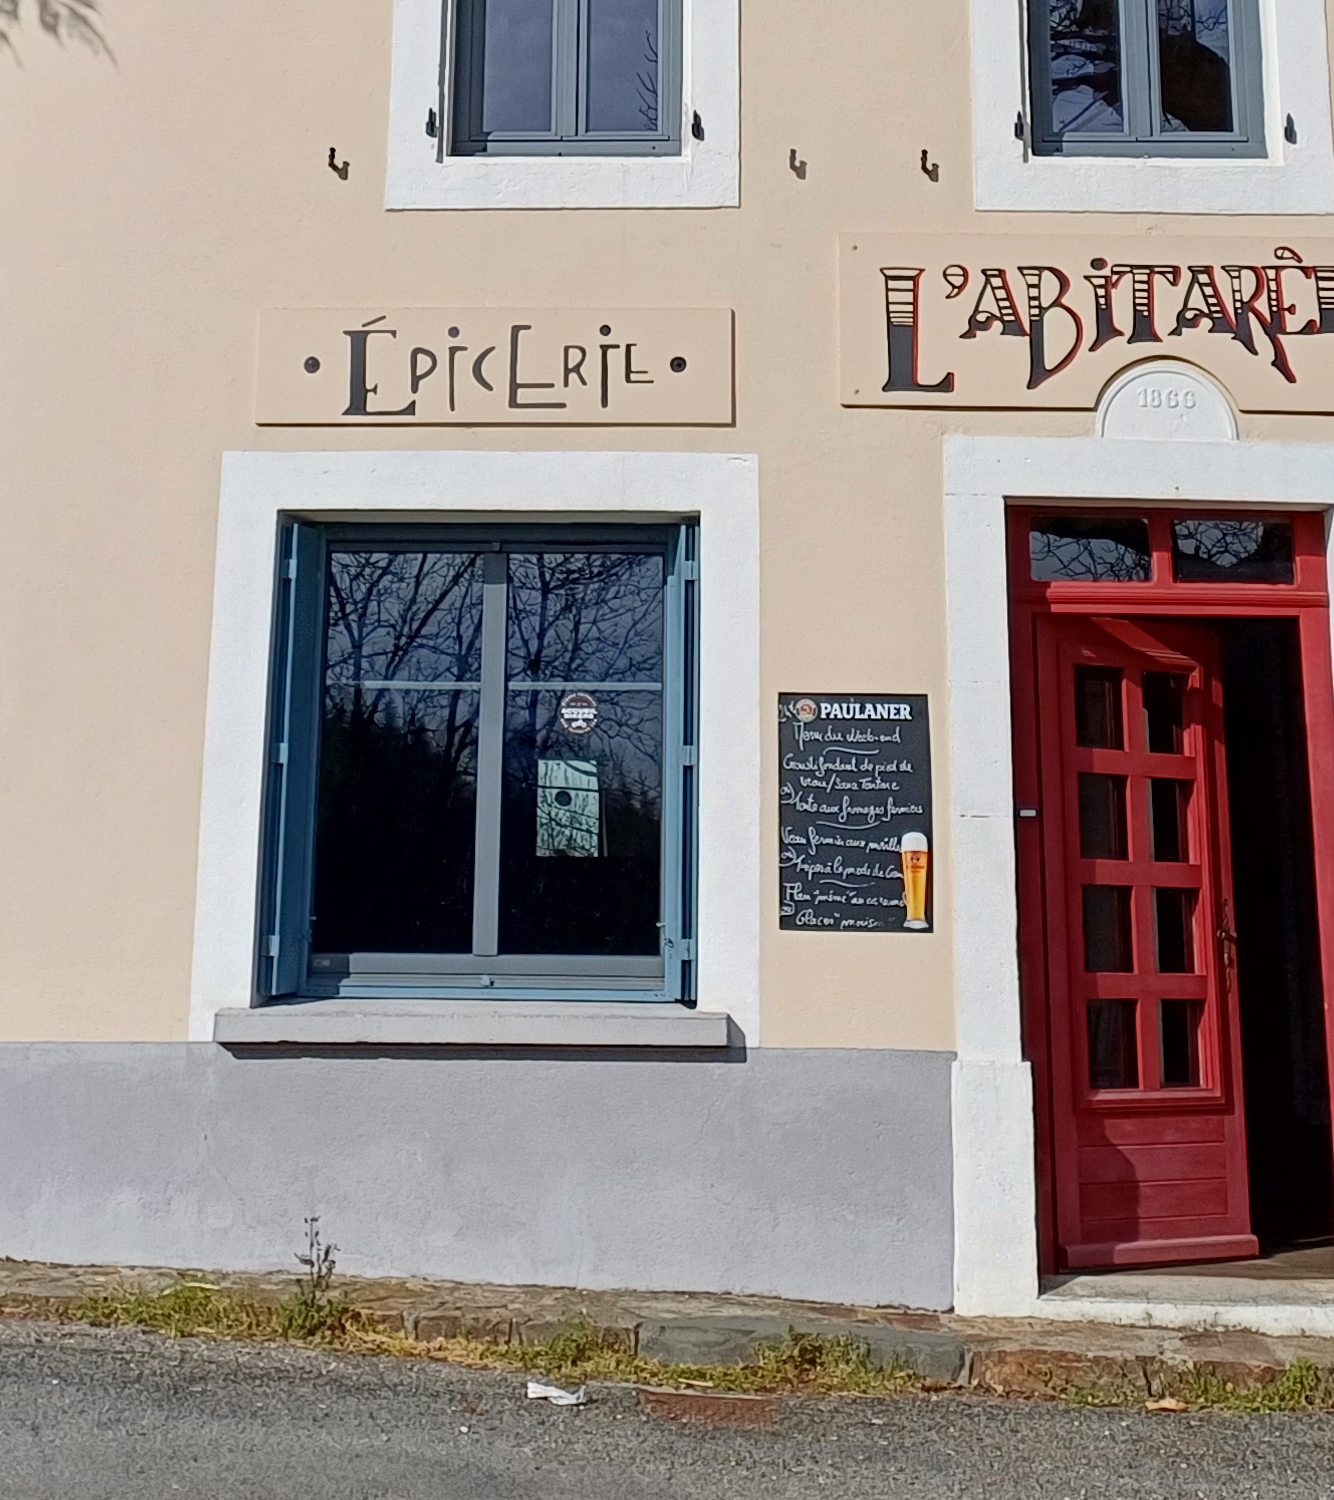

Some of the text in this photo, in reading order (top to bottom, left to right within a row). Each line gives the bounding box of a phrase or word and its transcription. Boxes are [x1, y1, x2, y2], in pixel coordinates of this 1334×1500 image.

[1137, 387, 1197, 409] 1866
[819, 702, 913, 720] PAULANER
[824, 725, 844, 741] du
[859, 757, 873, 772] de
[899, 759, 913, 773] de
[819, 804, 840, 814] aux
[845, 838, 866, 848] aux
